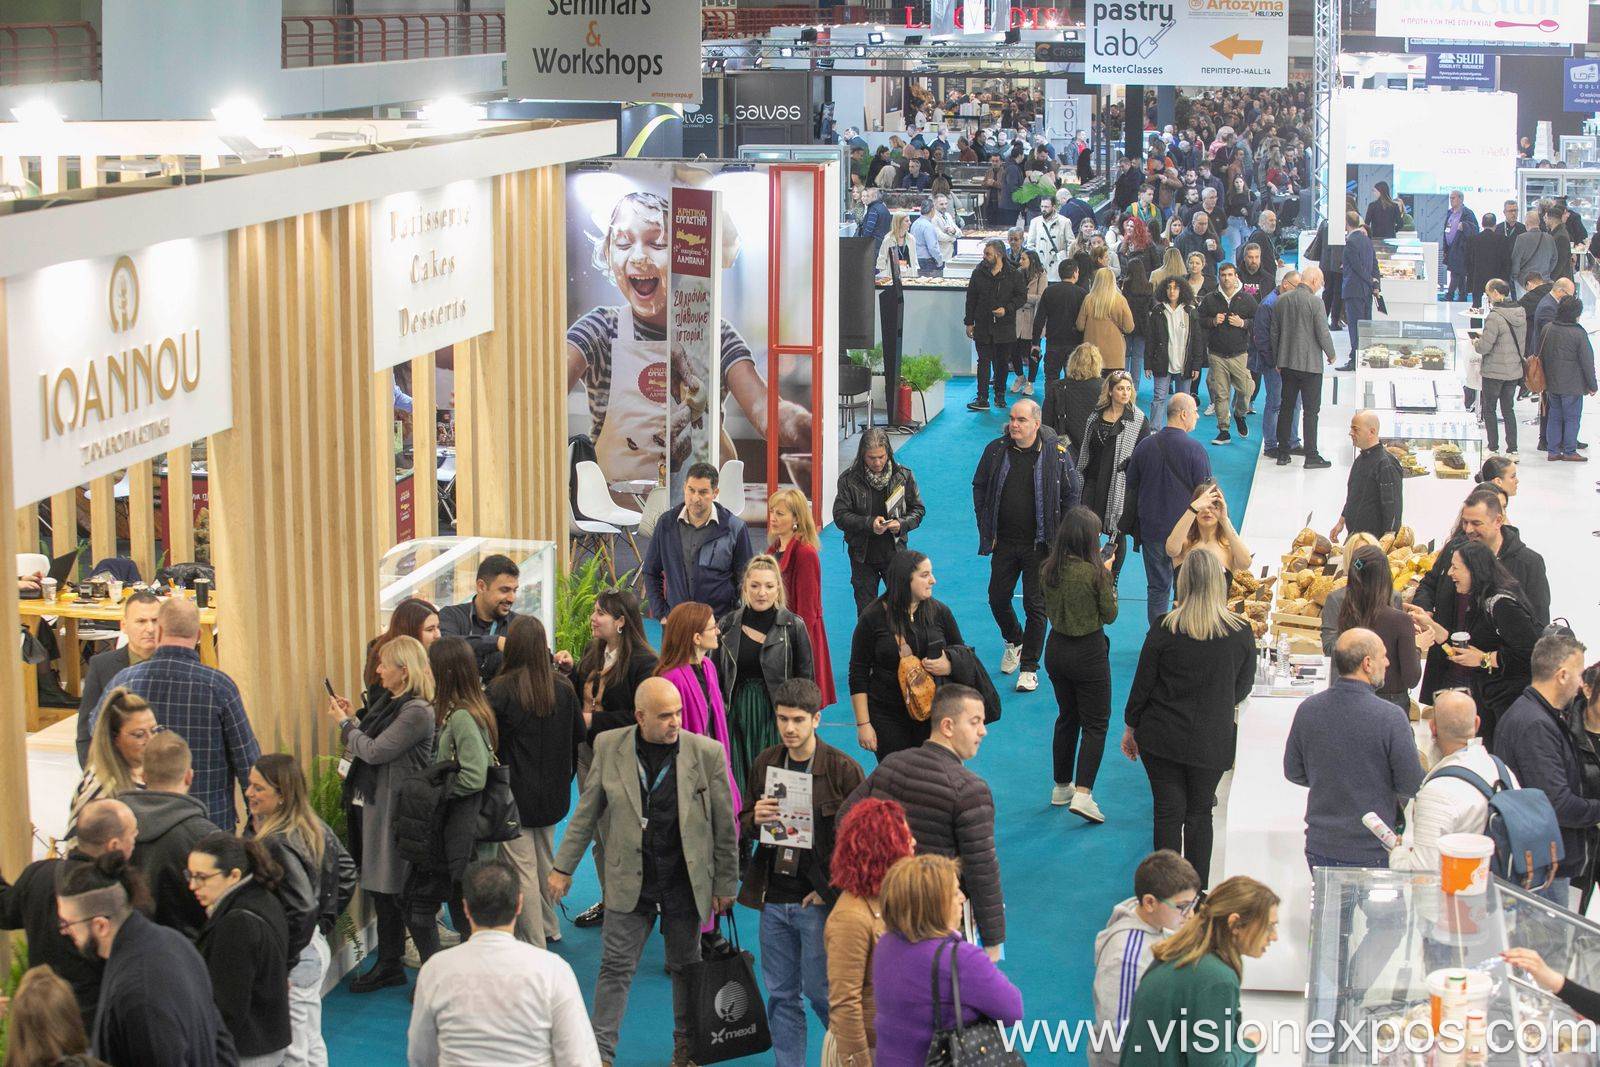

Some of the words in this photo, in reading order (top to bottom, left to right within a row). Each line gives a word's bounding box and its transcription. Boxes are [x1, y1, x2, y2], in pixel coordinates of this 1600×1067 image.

[547, 0, 652, 16] Seminars
[1093, 0, 1175, 27] pastry
[586, 20, 602, 48] &
[1093, 28, 1139, 57] lab
[532, 47, 664, 84] Workshops
[1092, 64, 1164, 75] MasterClasses
[410, 248, 456, 285] Cakes
[398, 297, 467, 337] Desserts
[725, 1023, 757, 1040] mexil
